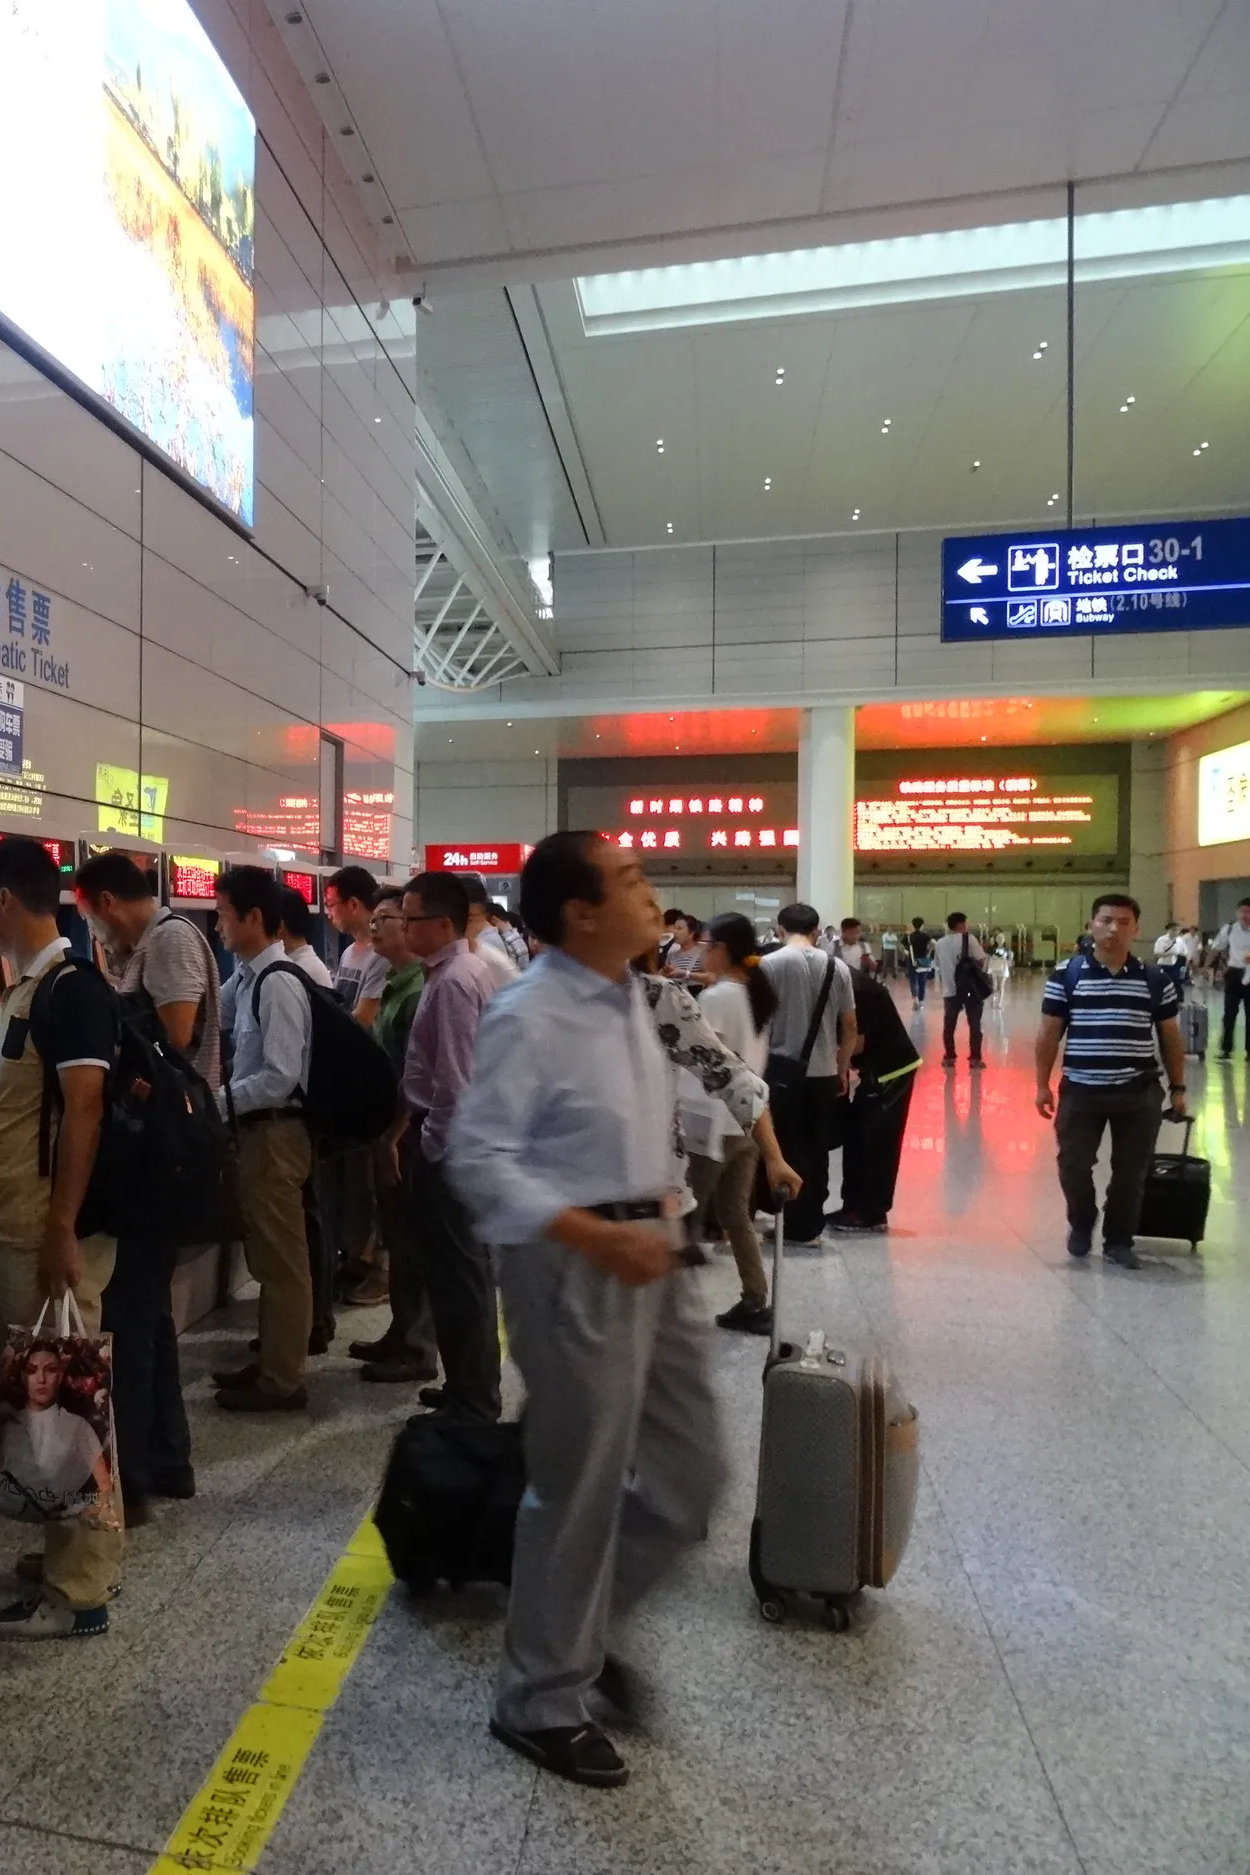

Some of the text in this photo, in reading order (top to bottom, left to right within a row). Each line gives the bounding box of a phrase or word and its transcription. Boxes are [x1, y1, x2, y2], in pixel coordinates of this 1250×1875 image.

[1067, 535, 1203, 570] 检票口 30-1
[1067, 565, 1179, 585] Ticket Check
[1075, 597, 1108, 613] 地铁
[1075, 612, 1115, 624] Subway
[31, 647, 70, 689] Ticket
[443, 851, 469, 866] 24h
